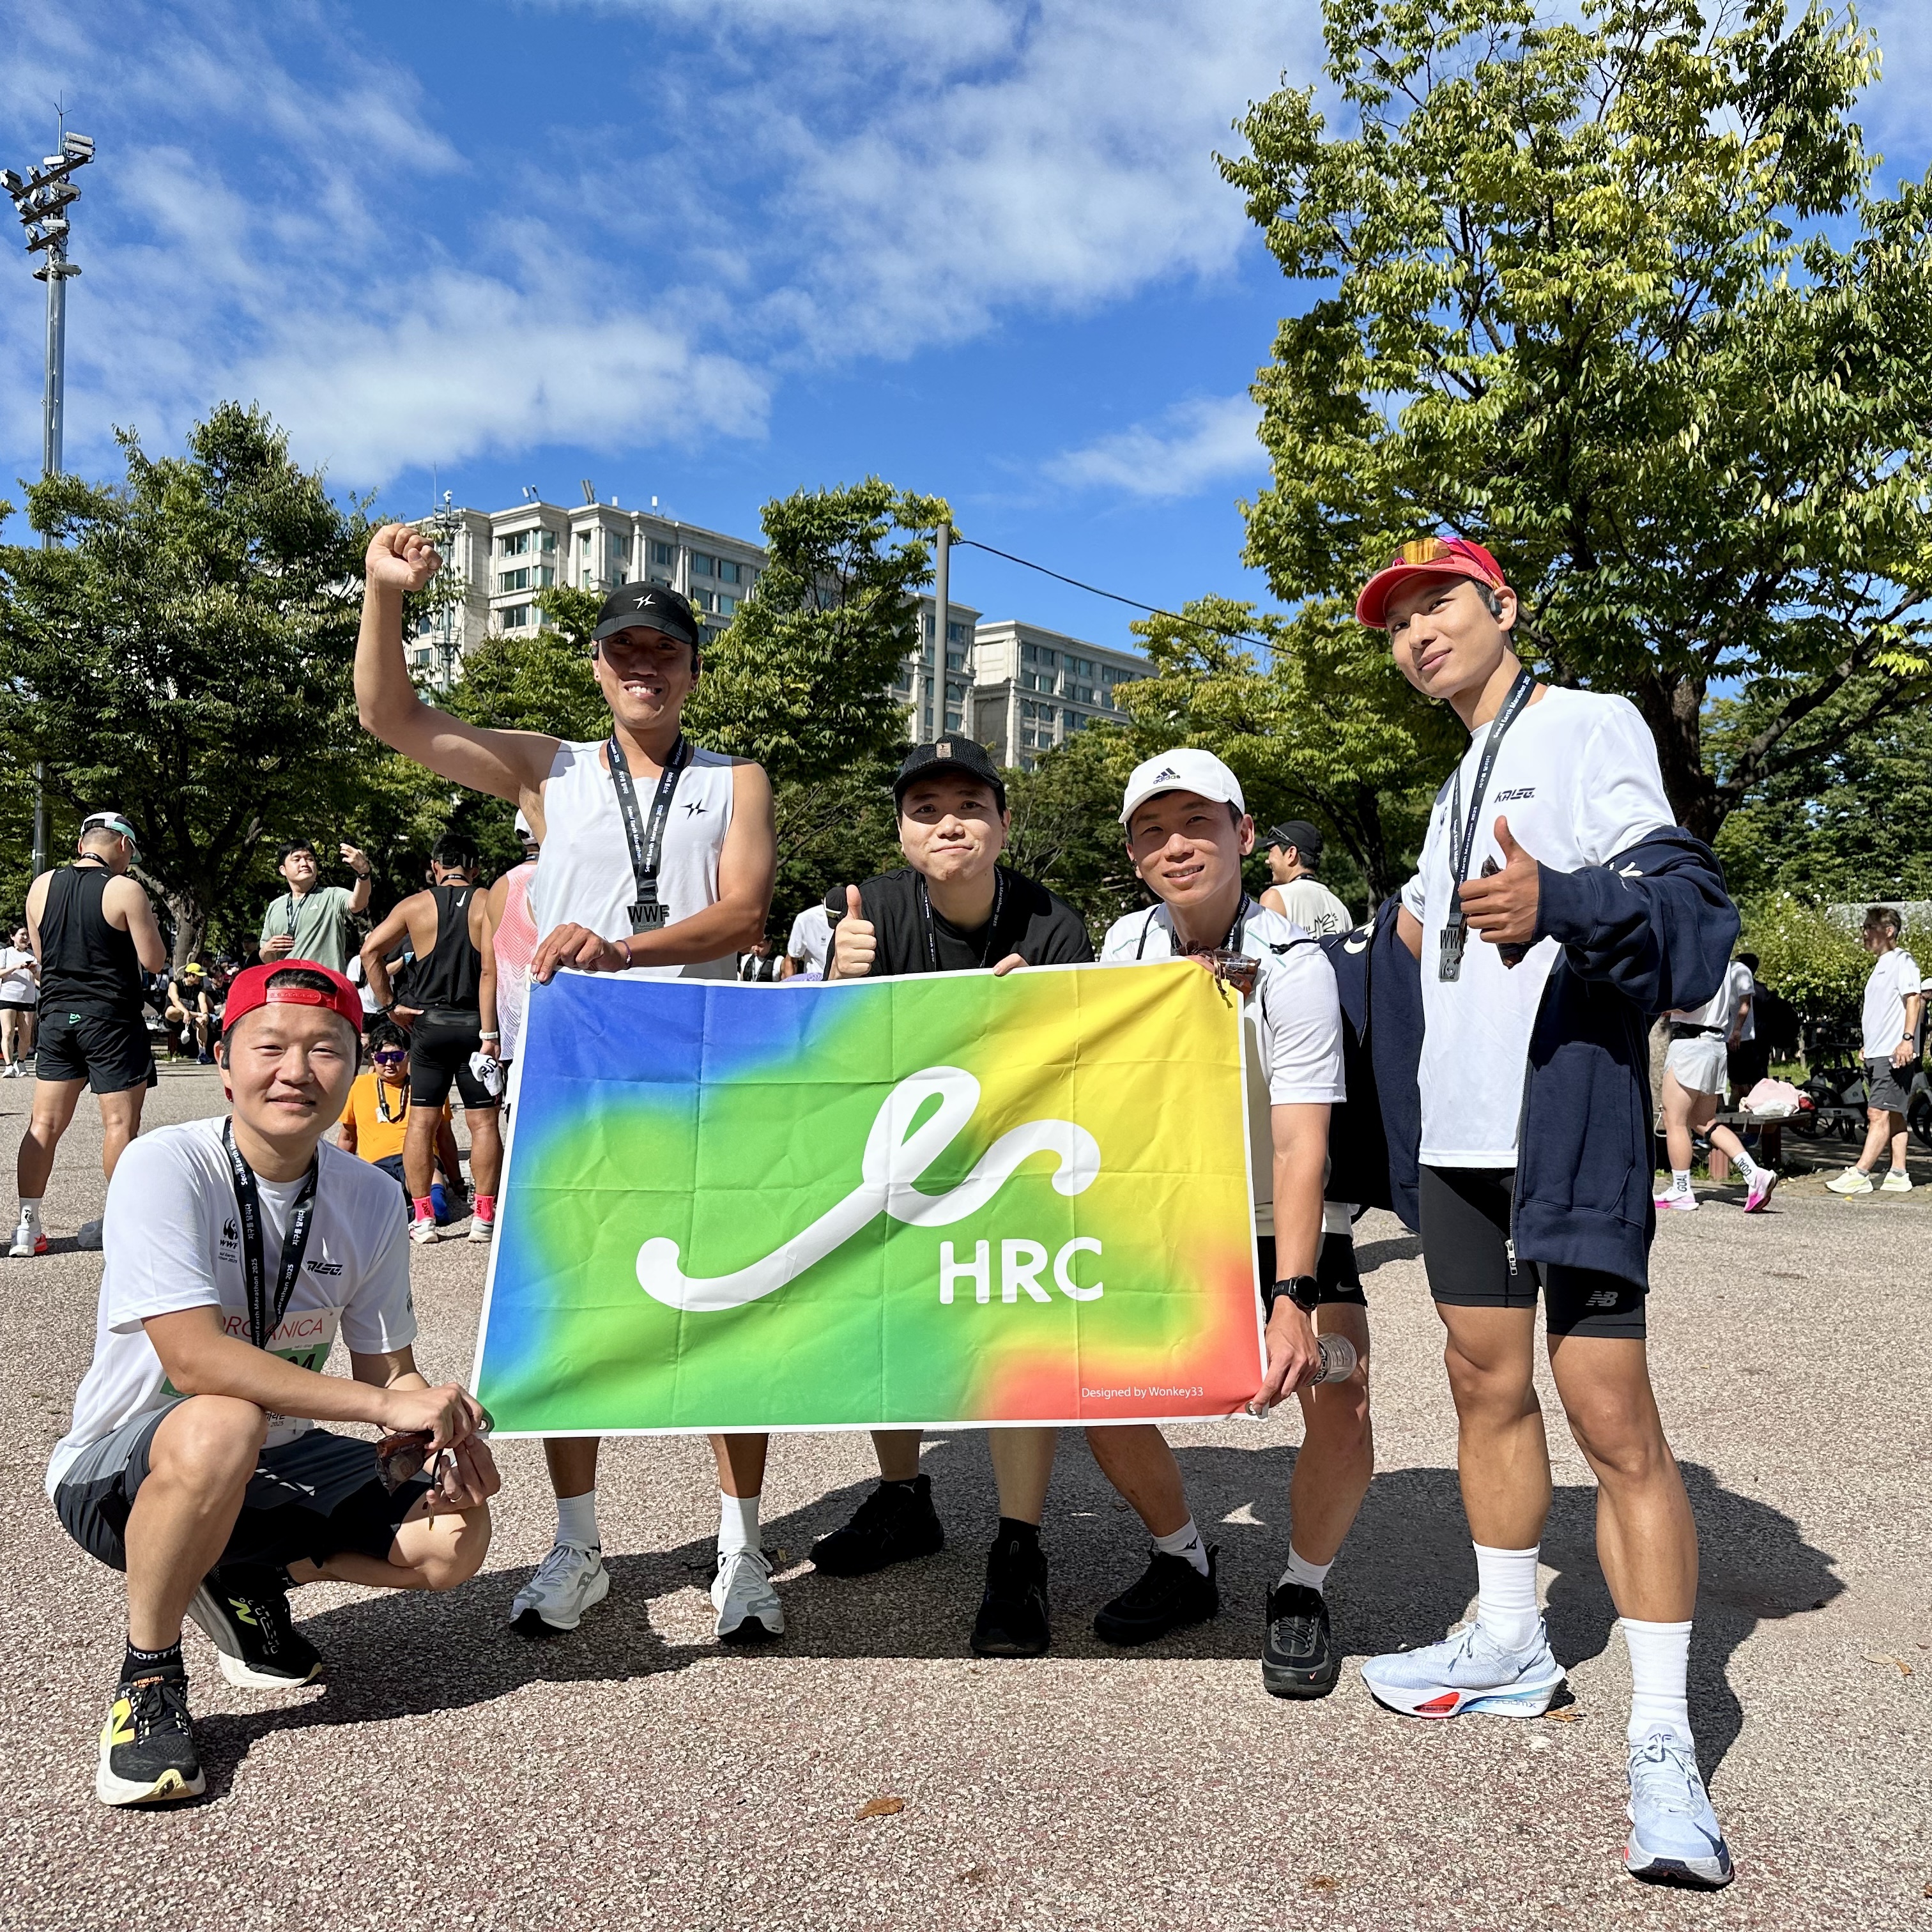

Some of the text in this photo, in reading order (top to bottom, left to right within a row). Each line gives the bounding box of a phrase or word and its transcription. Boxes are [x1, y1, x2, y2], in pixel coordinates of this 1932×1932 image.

[1501, 708, 1514, 723] Earth
[1511, 685, 1526, 709] Marathon
[1153, 774, 1181, 785] adidas
[650, 817, 660, 842] Marathon
[627, 905, 670, 923] WWF
[232, 1151, 243, 1167] Earth
[237, 1167, 248, 1186] Seoul
[244, 1203, 254, 1239] 지구를 달리다
[292, 1210, 305, 1245] 지구를 달리다
[286, 1264, 294, 1280] 2025
[939, 1236, 1104, 1304] HRC
[1082, 1386, 1204, 1400] Designed by Wonkey33
